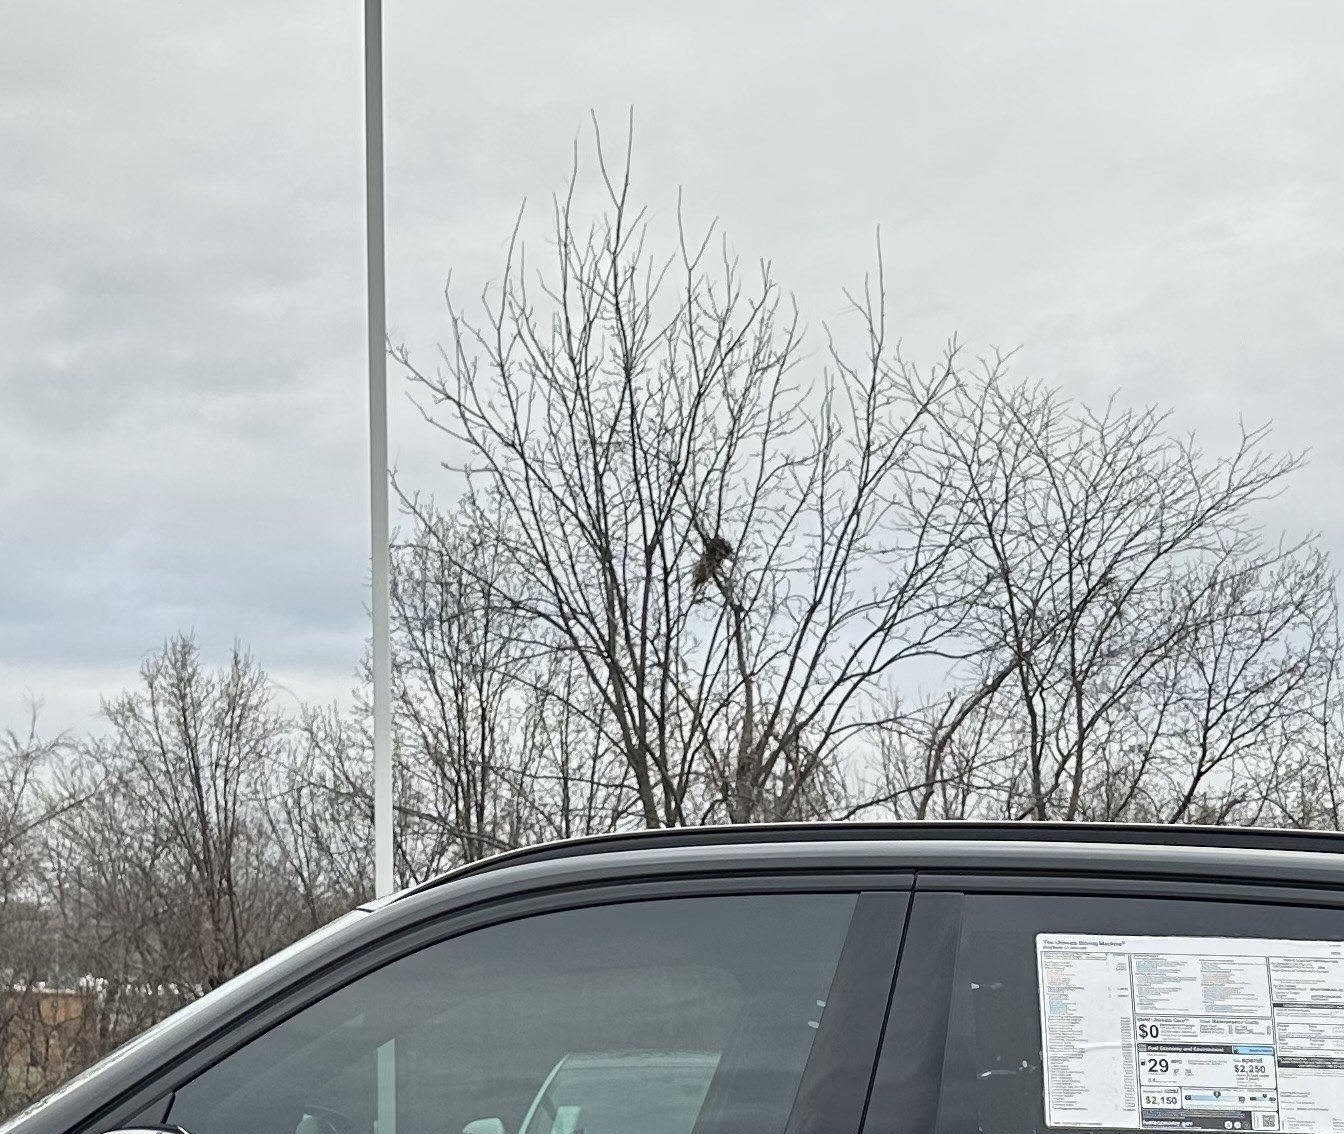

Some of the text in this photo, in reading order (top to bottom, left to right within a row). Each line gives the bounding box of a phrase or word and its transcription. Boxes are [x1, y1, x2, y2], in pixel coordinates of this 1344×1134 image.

[1138, 1024, 1159, 1039] $0
[1148, 1058, 1169, 1073] 29
[1234, 1064, 1266, 1074] $2,250
[1145, 1095, 1178, 1106] $2,150
